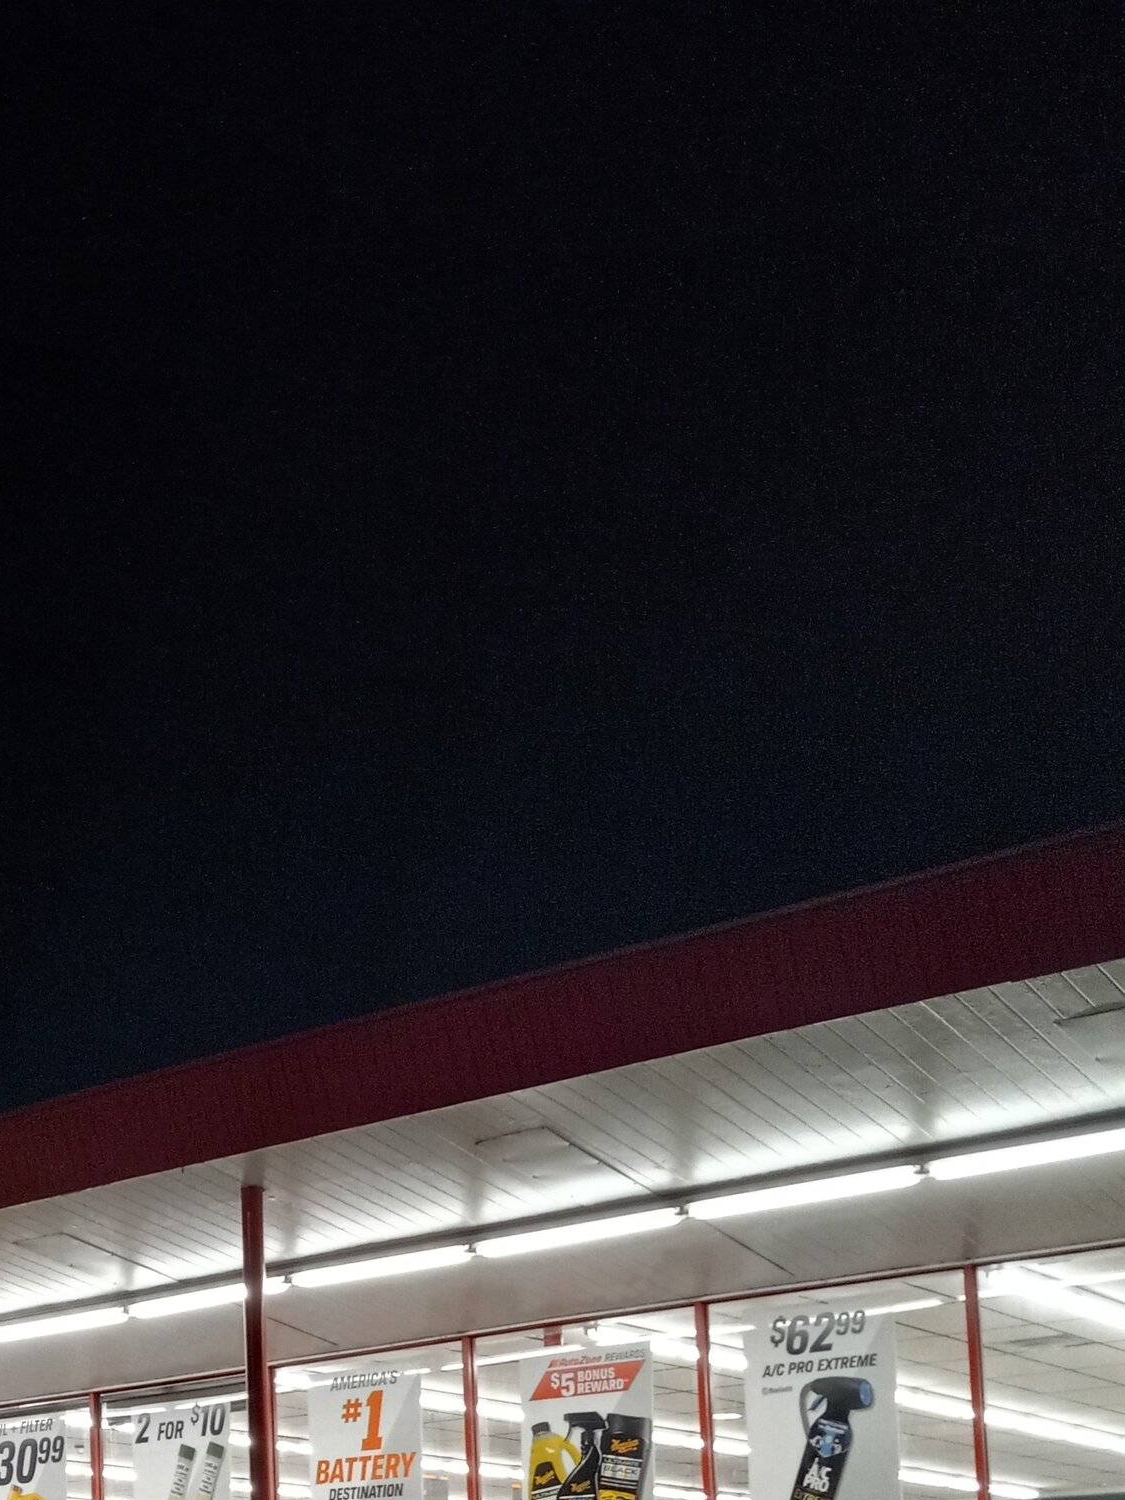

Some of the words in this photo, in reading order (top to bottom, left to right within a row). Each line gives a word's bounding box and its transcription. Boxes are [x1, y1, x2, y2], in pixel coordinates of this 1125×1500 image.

[577, 1367, 615, 1382] BONUS
[763, 1363, 784, 1378] A/C
[788, 1359, 813, 1374] PRO
[817, 1353, 878, 1371] EXTREME
[330, 1371, 398, 1391] AMERICA'S
[551, 1372, 575, 1397] $5
[577, 1379, 625, 1394] REWARD
[20, 1418, 53, 1434] FILTER
[135, 1413, 151, 1444] 2
[157, 1420, 185, 1441] FOR
[191, 1402, 225, 1436] $10
[342, 1390, 383, 1450] #1
[315, 1452, 417, 1485] BATTERY
[329, 1483, 404, 1500] DESTINATION
